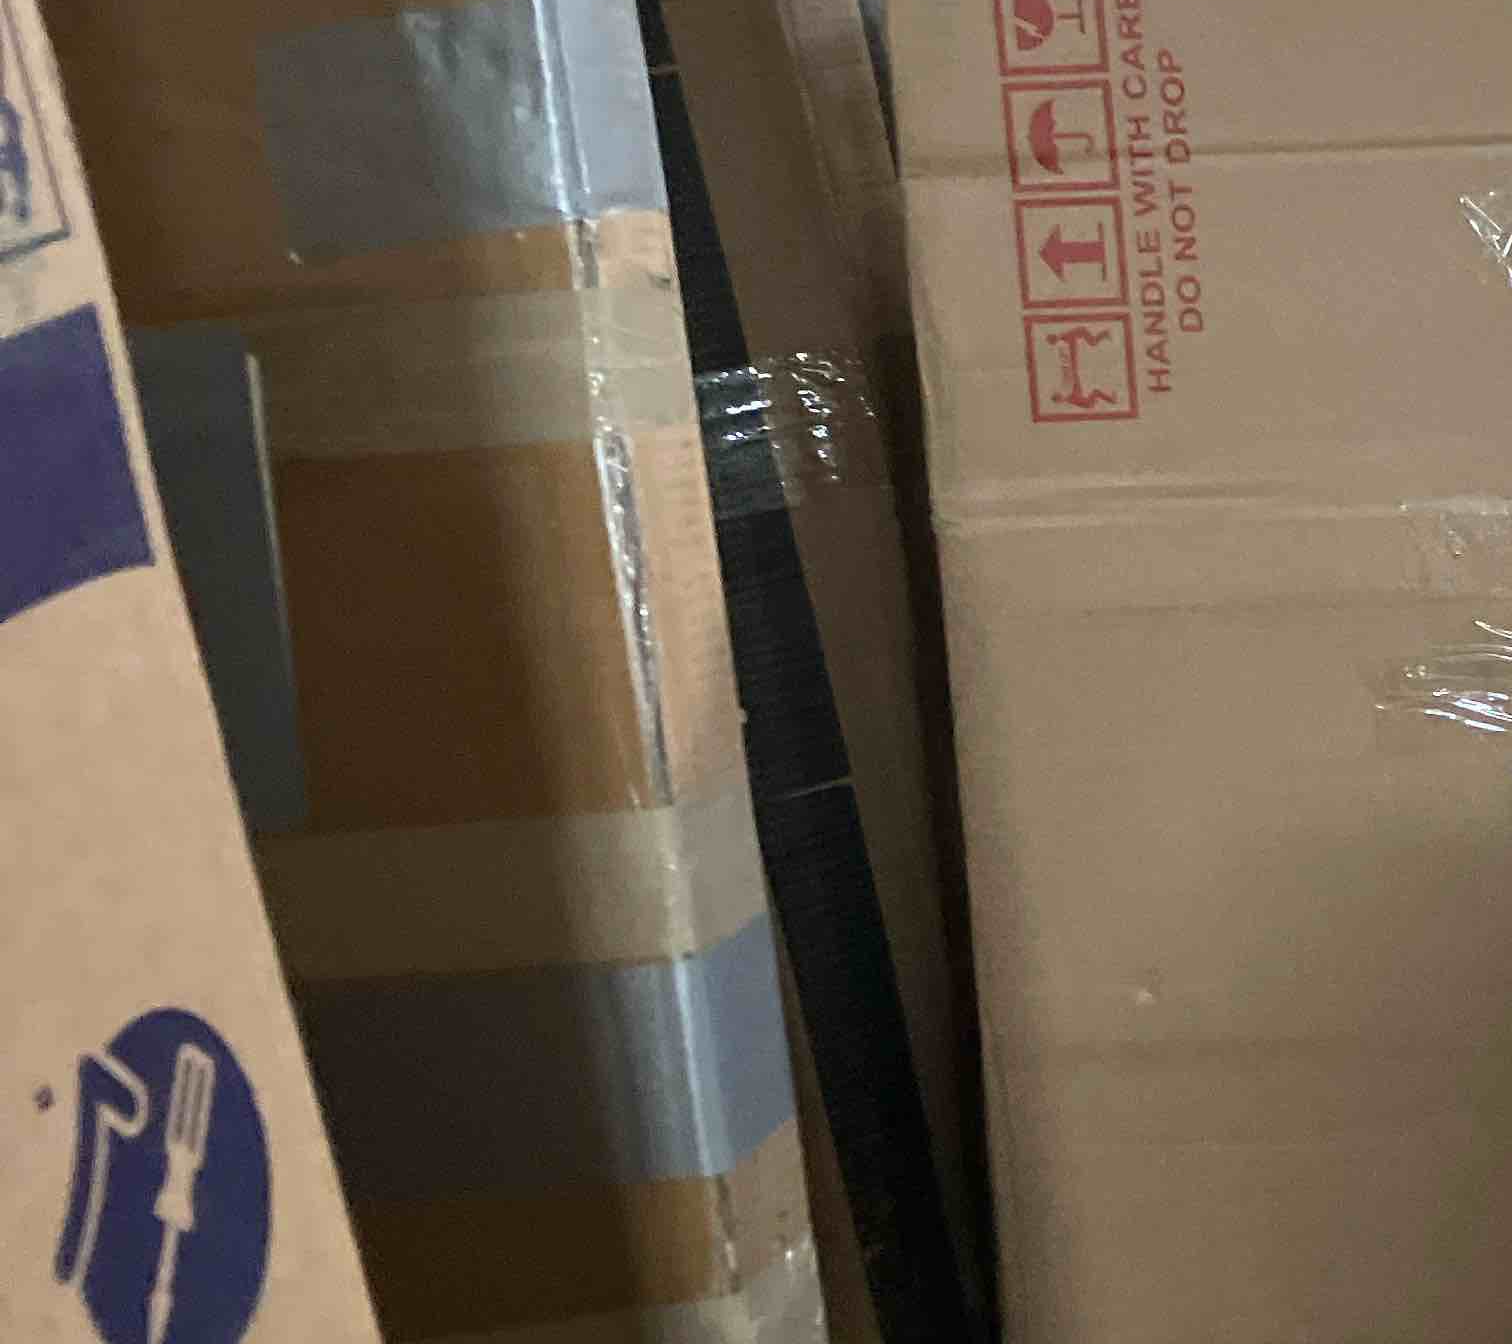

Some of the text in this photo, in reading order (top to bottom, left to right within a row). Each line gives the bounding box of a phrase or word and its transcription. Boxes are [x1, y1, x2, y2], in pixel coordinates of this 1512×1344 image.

[1127, 115, 1160, 217] WITH
[1156, 48, 1204, 333] DO NOT DROP
[1137, 228, 1172, 392] HANDLE
